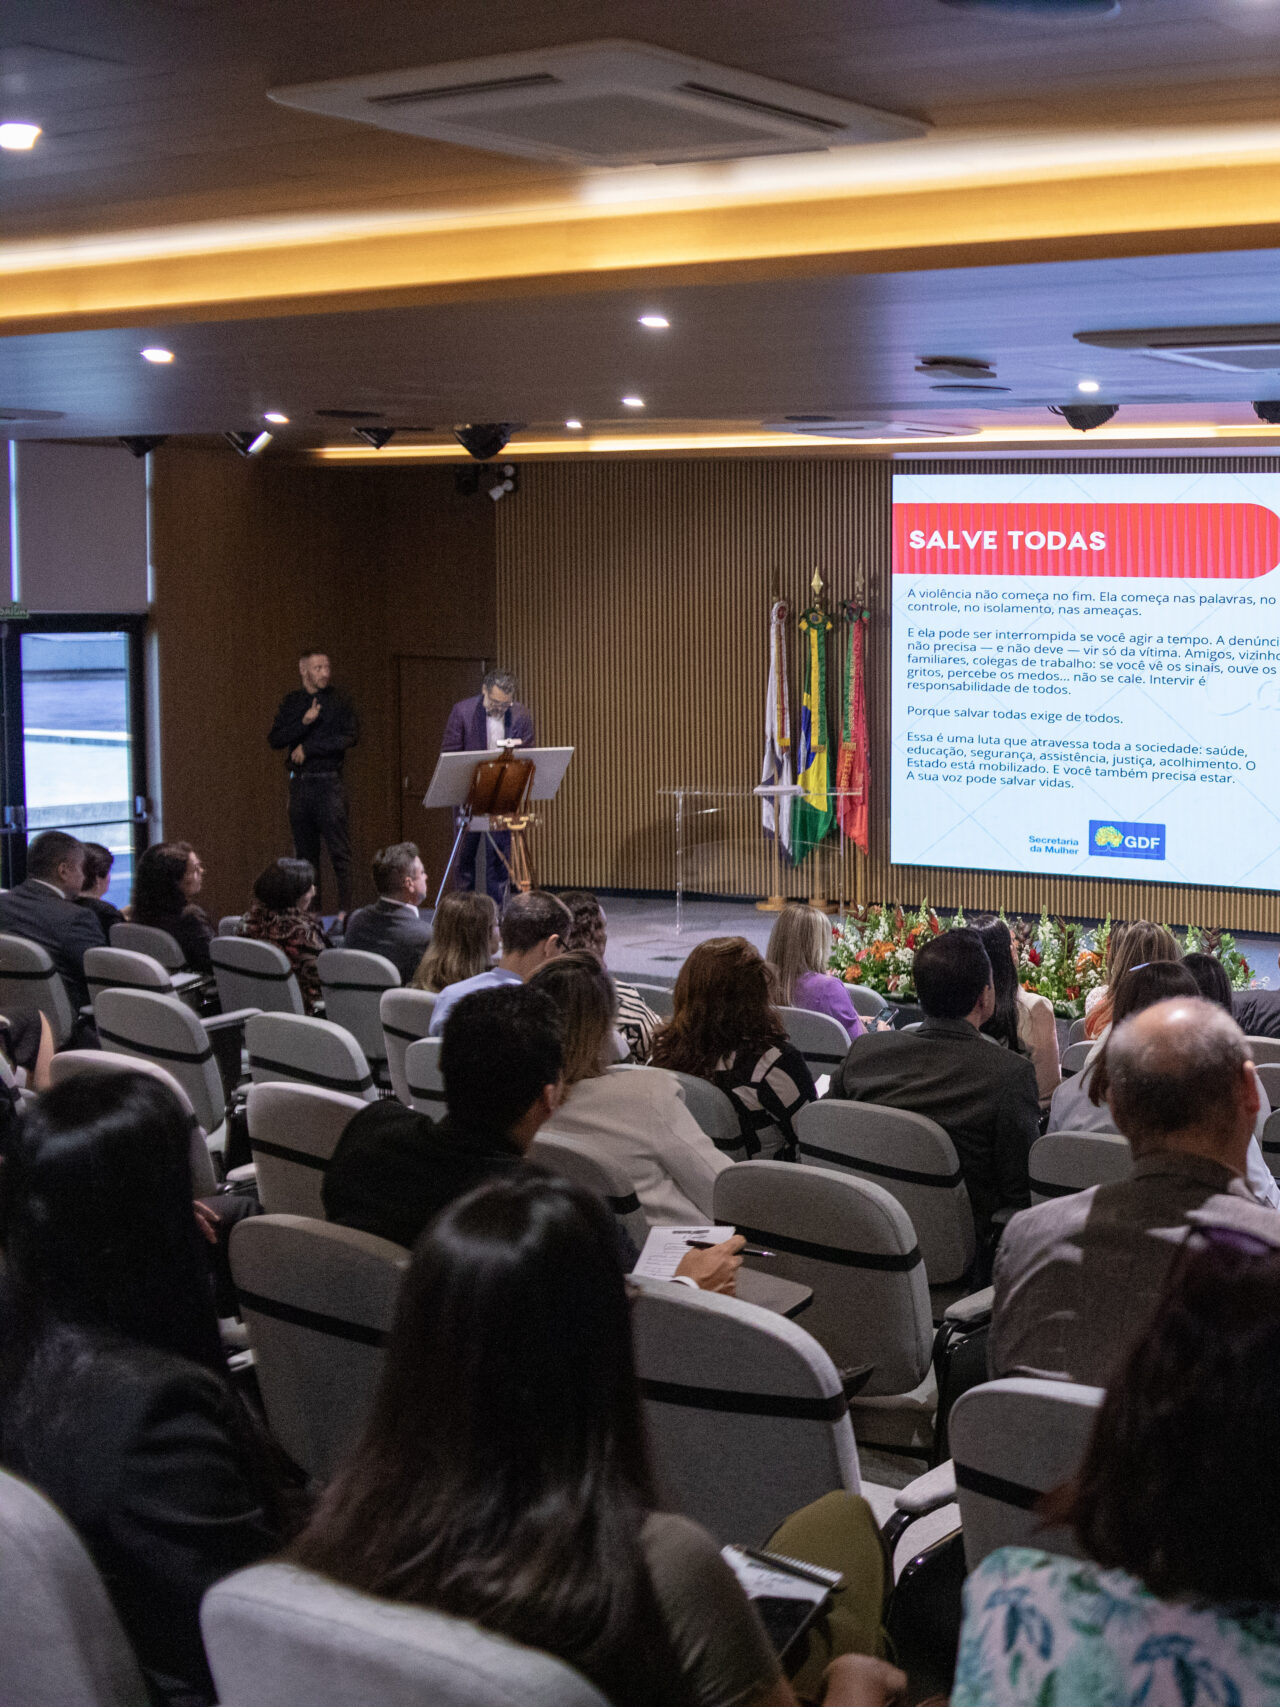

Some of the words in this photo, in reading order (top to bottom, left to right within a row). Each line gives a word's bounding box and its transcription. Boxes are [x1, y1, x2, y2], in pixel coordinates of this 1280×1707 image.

[909, 529, 997, 550] SALVE
[1007, 530, 1106, 551] TODAS
[907, 588, 916, 598] A
[918, 588, 972, 599] violência
[975, 589, 998, 599] não
[1001, 592, 1049, 603] começa
[1053, 593, 1069, 601] no
[1072, 590, 1095, 601] fim.
[1099, 591, 1117, 602] Ela
[1120, 594, 1169, 606] começa
[1173, 595, 1196, 603] nas
[1199, 593, 1256, 606] palavras,
[1260, 596, 1276, 605] no
[907, 601, 960, 613] controle,
[964, 604, 980, 612] no
[983, 603, 1054, 615] isolamento,
[1058, 606, 1080, 615] nas
[1083, 607, 1142, 618] ameaças.
[907, 627, 914, 637] E
[917, 627, 935, 638] ela
[938, 628, 970, 640] pode
[973, 631, 992, 639] ser
[995, 631, 1076, 643] interrompida
[1080, 633, 1094, 642] se
[1096, 632, 1126, 643] você
[1129, 633, 1153, 646] agir
[1156, 636, 1164, 644] a
[1167, 635, 1212, 647] tempo.
[1215, 635, 1225, 645] A
[907, 640, 930, 650] não
[933, 642, 977, 653] precisa
[996, 645, 1004, 653] e
[1007, 643, 1031, 653] não
[1033, 643, 1064, 654] deve
[1083, 645, 1099, 655] vir
[1102, 645, 1117, 656] só
[1120, 646, 1136, 657] da
[1139, 646, 1181, 658] vítima.
[1184, 648, 1235, 662] Amigos,
[907, 653, 969, 666] familiares,
[972, 655, 1018, 670] colegas
[1021, 656, 1037, 667] de
[1040, 657, 1096, 669] trabalho:
[1099, 661, 1113, 669] se
[1116, 660, 1145, 670] você
[1148, 660, 1163, 671] vê
[1166, 663, 1182, 671] os
[1184, 662, 1223, 674] sinais,
[1227, 665, 1259, 674] ouve
[1262, 666, 1277, 675] os
[906, 668, 944, 679] gritos,
[947, 668, 997, 683] percebe
[999, 671, 1014, 679] os
[1017, 670, 1070, 681] medos...
[1073, 672, 1097, 682] não
[1100, 674, 1114, 683] se
[1117, 673, 1145, 684] cale.
[1150, 674, 1195, 685] Intervir
[1198, 675, 1206, 686] é
[907, 681, 1011, 692] responsabilidade
[1014, 683, 1030, 693] de
[1033, 684, 1071, 695] todos.
[907, 705, 951, 718] Porque
[954, 707, 990, 718] salvar
[993, 709, 1027, 720] todas
[1030, 712, 1062, 724] exige
[1066, 711, 1081, 722] de
[1085, 713, 1123, 724] todos.
[907, 731, 933, 742] Essa
[936, 732, 944, 742] é
[947, 735, 974, 744] uma
[977, 734, 1000, 745] luta
[1004, 737, 1027, 748] que
[1030, 738, 1089, 749] atravessa
[1092, 740, 1121, 750] toda
[1124, 743, 1131, 751] a
[1135, 742, 1202, 754] sociedade:
[1205, 745, 1247, 758] saúde,
[906, 745, 967, 760] educação,
[970, 749, 1036, 763] segurança,
[1039, 751, 1109, 764] assistência,
[1111, 754, 1156, 768] justiça,
[1159, 757, 1242, 770] acolhimento.
[1245, 760, 1256, 771] O
[906, 770, 915, 780] A
[917, 773, 939, 781] sua
[942, 774, 962, 782] voz
[966, 774, 997, 786] pode
[1000, 775, 1036, 786] salvar
[1039, 777, 1074, 788] vidas.
[907, 757, 947, 768] Estado
[950, 760, 975, 770] está
[979, 761, 1049, 773] mobilizado.
[1053, 764, 1059, 774] E
[1063, 765, 1092, 776] você
[1095, 767, 1148, 779] também
[1151, 770, 1196, 782] precisa
[1200, 774, 1235, 784] estar.
[1028, 835, 1079, 846] Secretaria
[1124, 835, 1161, 850] GDF
[1029, 845, 1042, 853] da
[1044, 845, 1079, 856] Mulher
